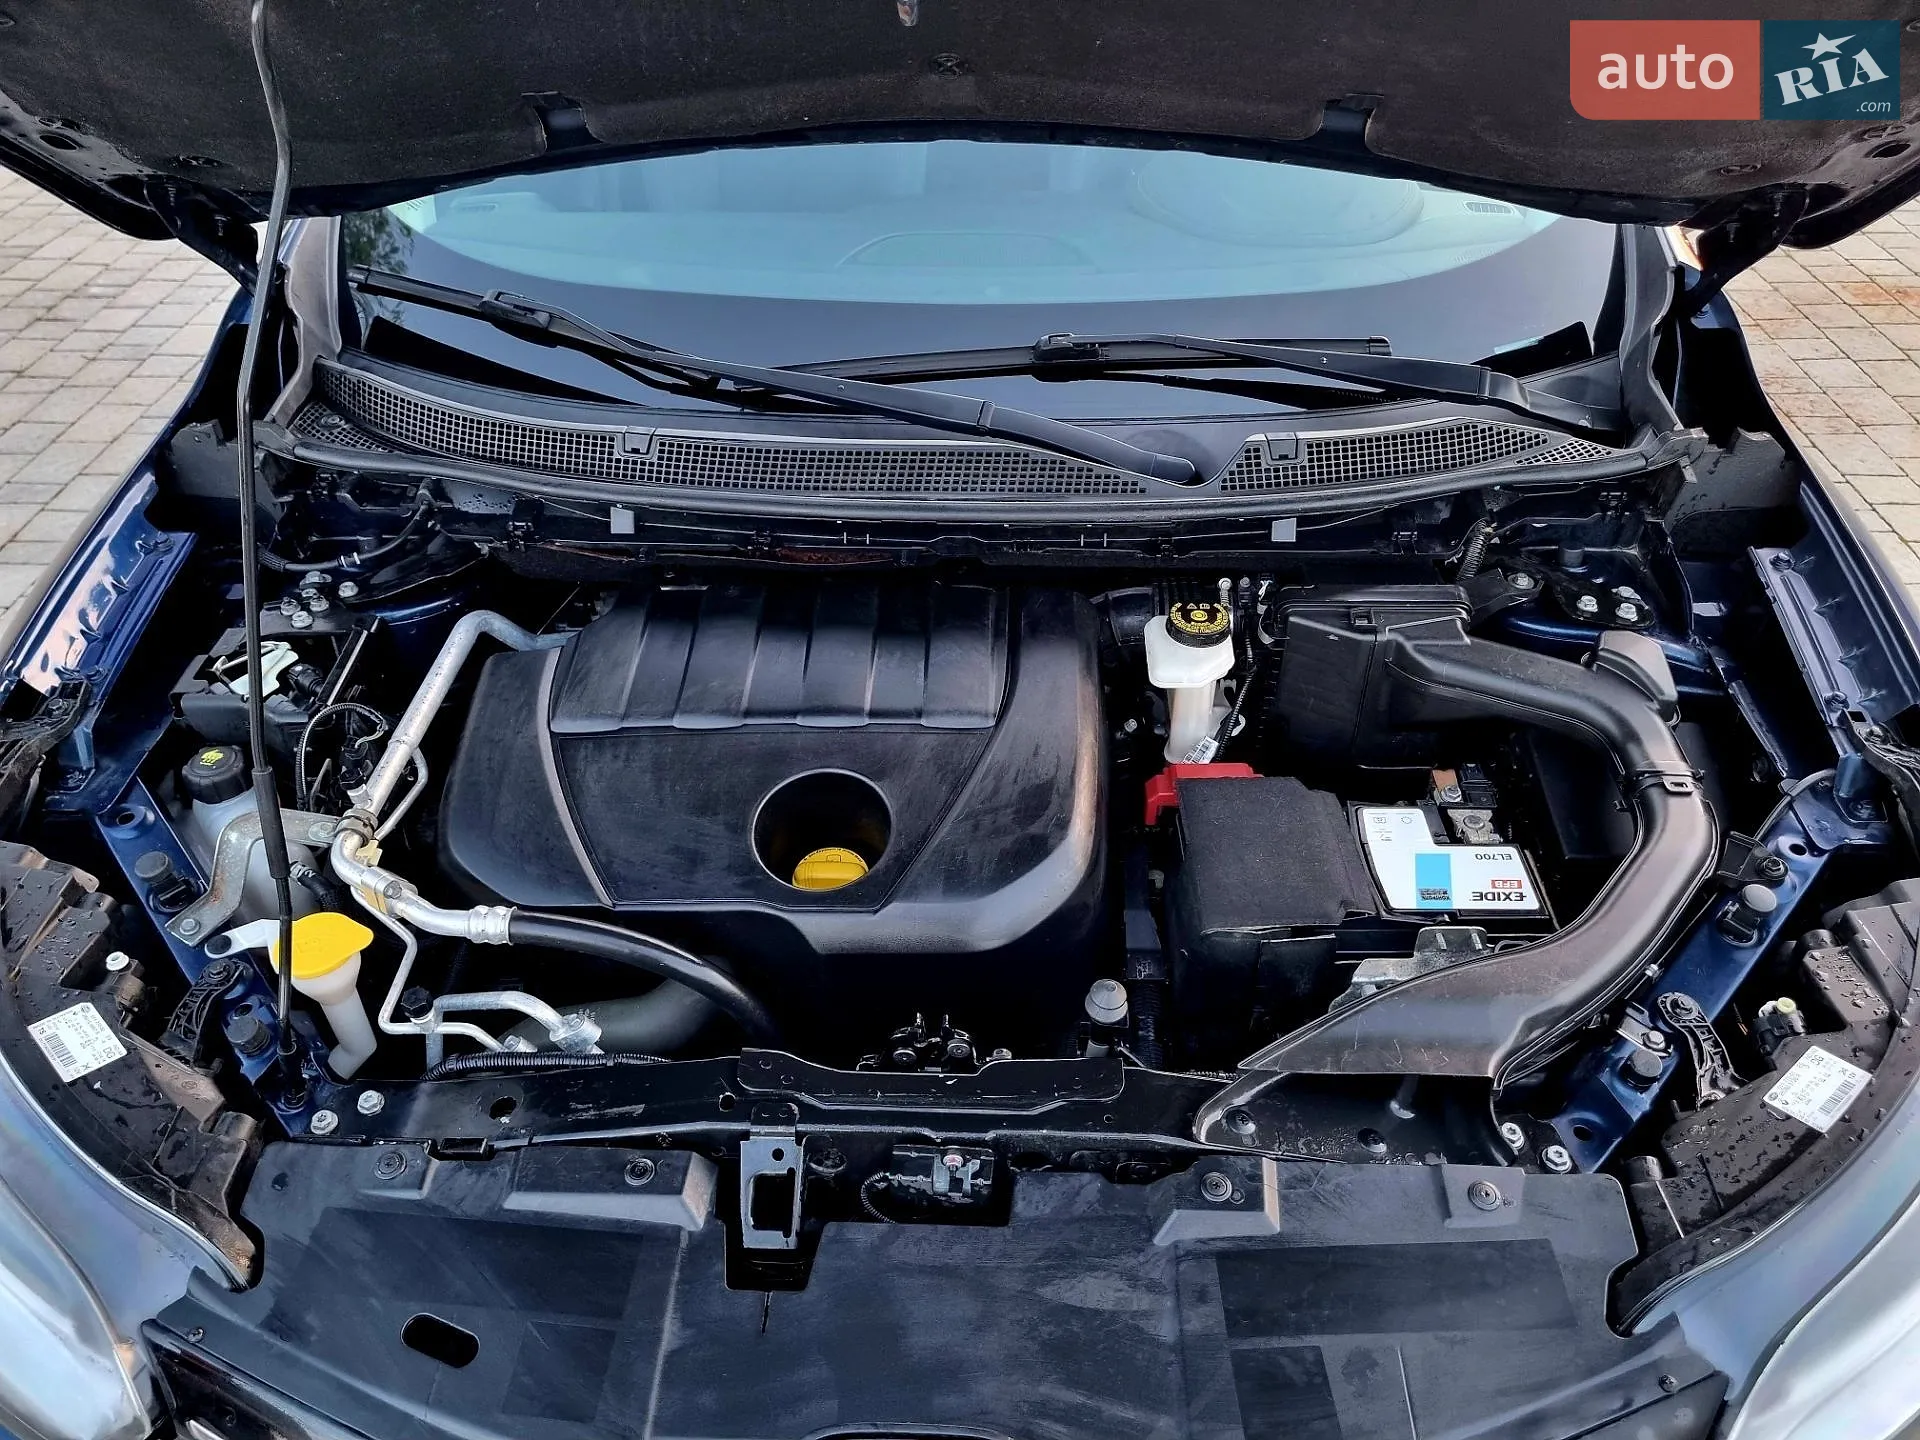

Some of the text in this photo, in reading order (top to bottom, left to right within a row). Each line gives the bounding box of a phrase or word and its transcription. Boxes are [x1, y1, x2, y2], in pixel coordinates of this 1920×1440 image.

[1475, 853, 1512, 861] EL700
[1495, 880, 1518, 888] EFB
[1471, 891, 1527, 902] EXIDE
